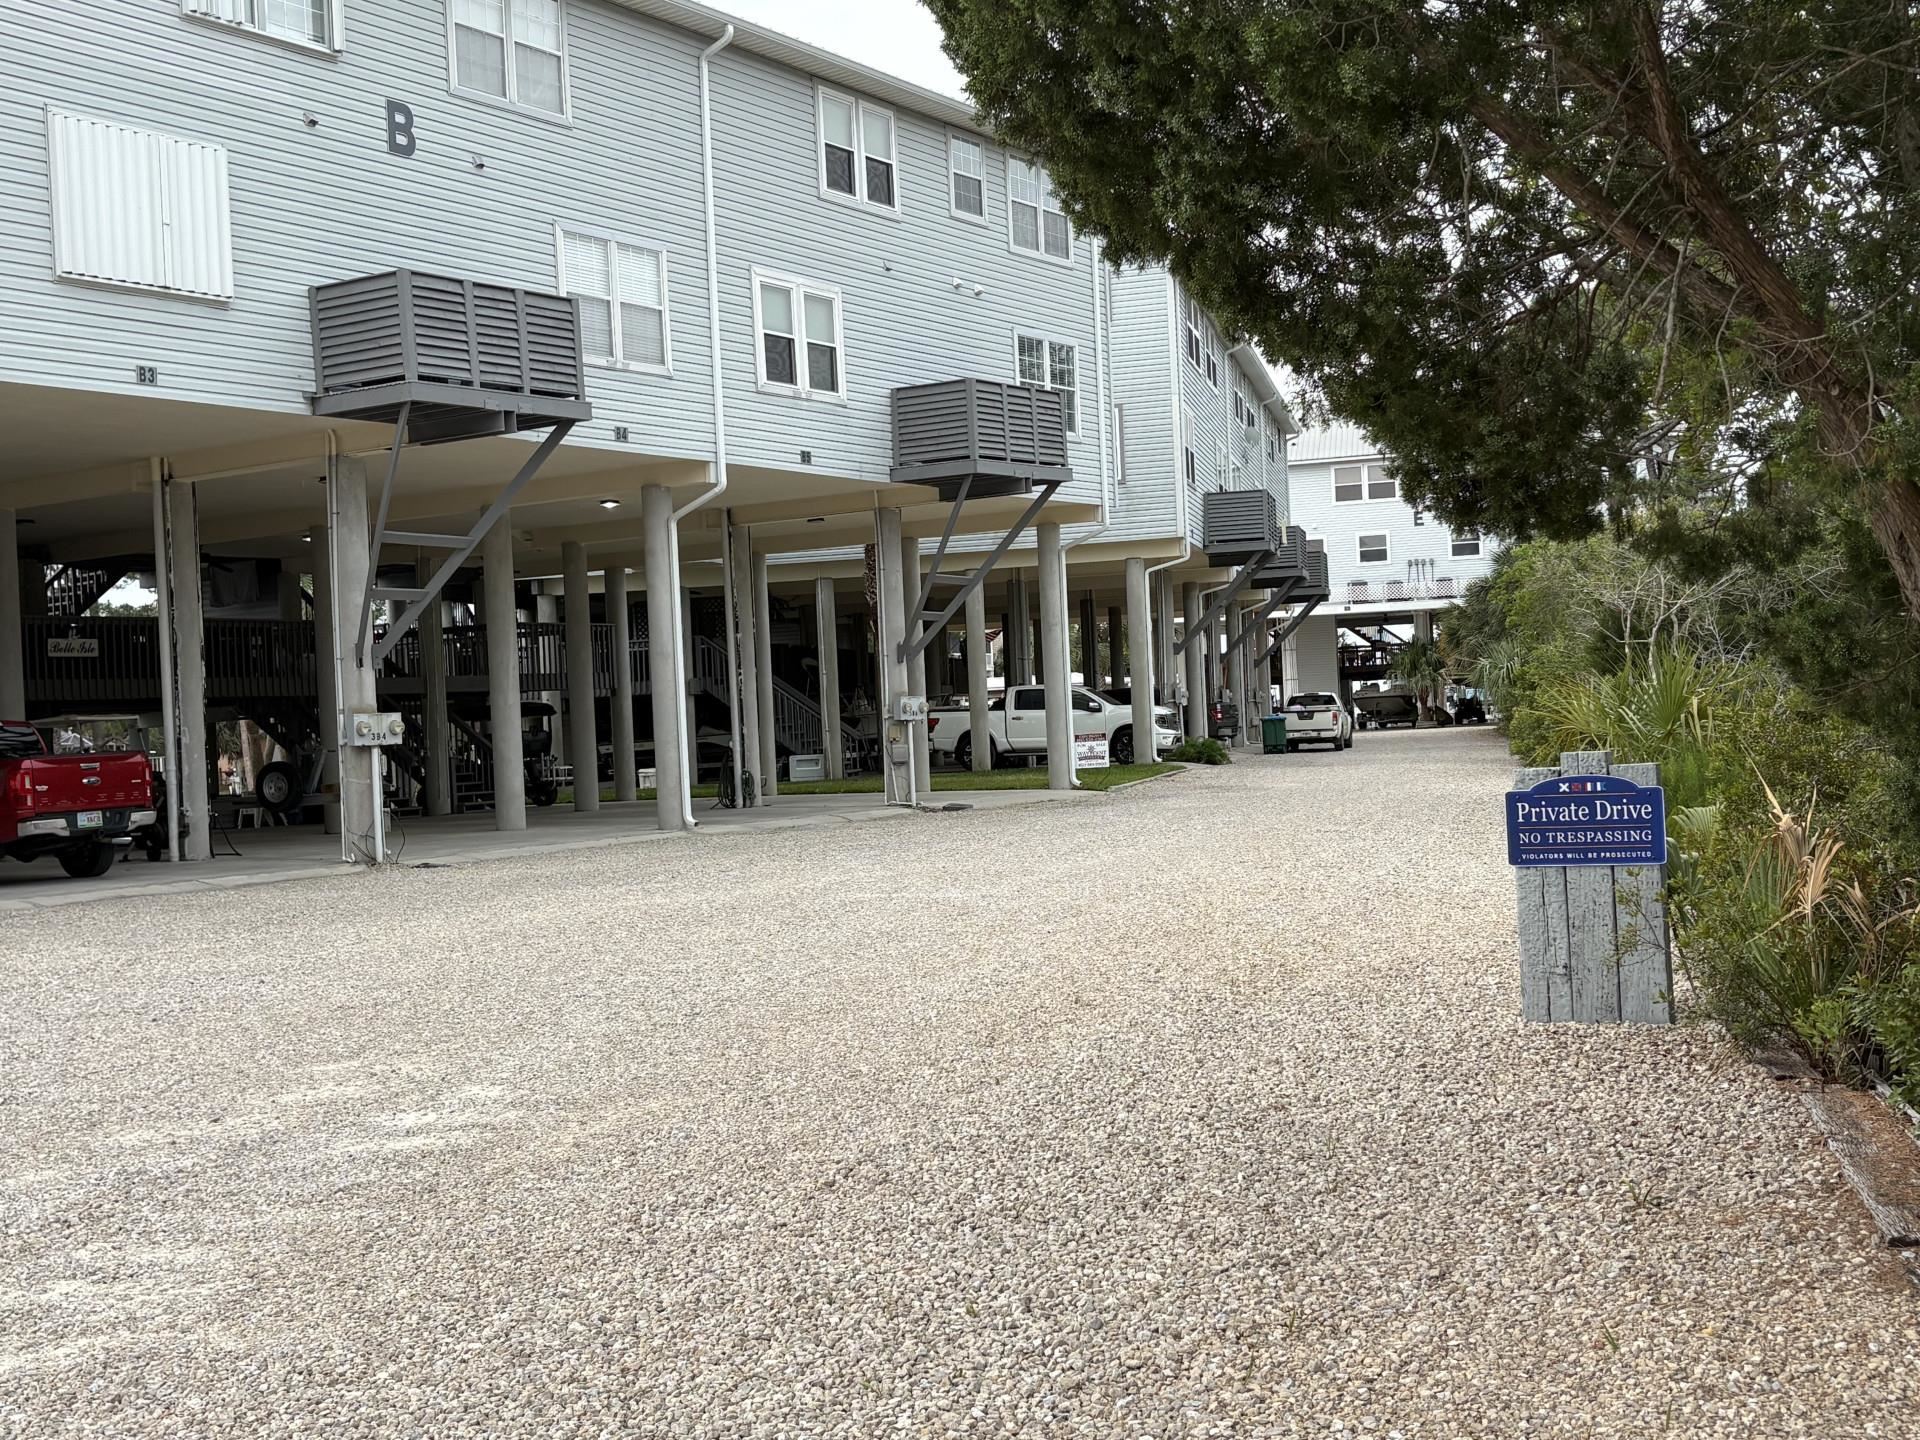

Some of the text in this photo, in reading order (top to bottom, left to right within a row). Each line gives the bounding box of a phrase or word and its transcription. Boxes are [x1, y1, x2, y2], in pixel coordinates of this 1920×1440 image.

[386, 99, 416, 157] B
[139, 366, 155, 383] B3
[616, 426, 627, 440] B4
[1413, 510, 1425, 526] E
[1516, 798, 1652, 823] Private Drive
[1519, 830, 1652, 844] NO TRESPASSING
